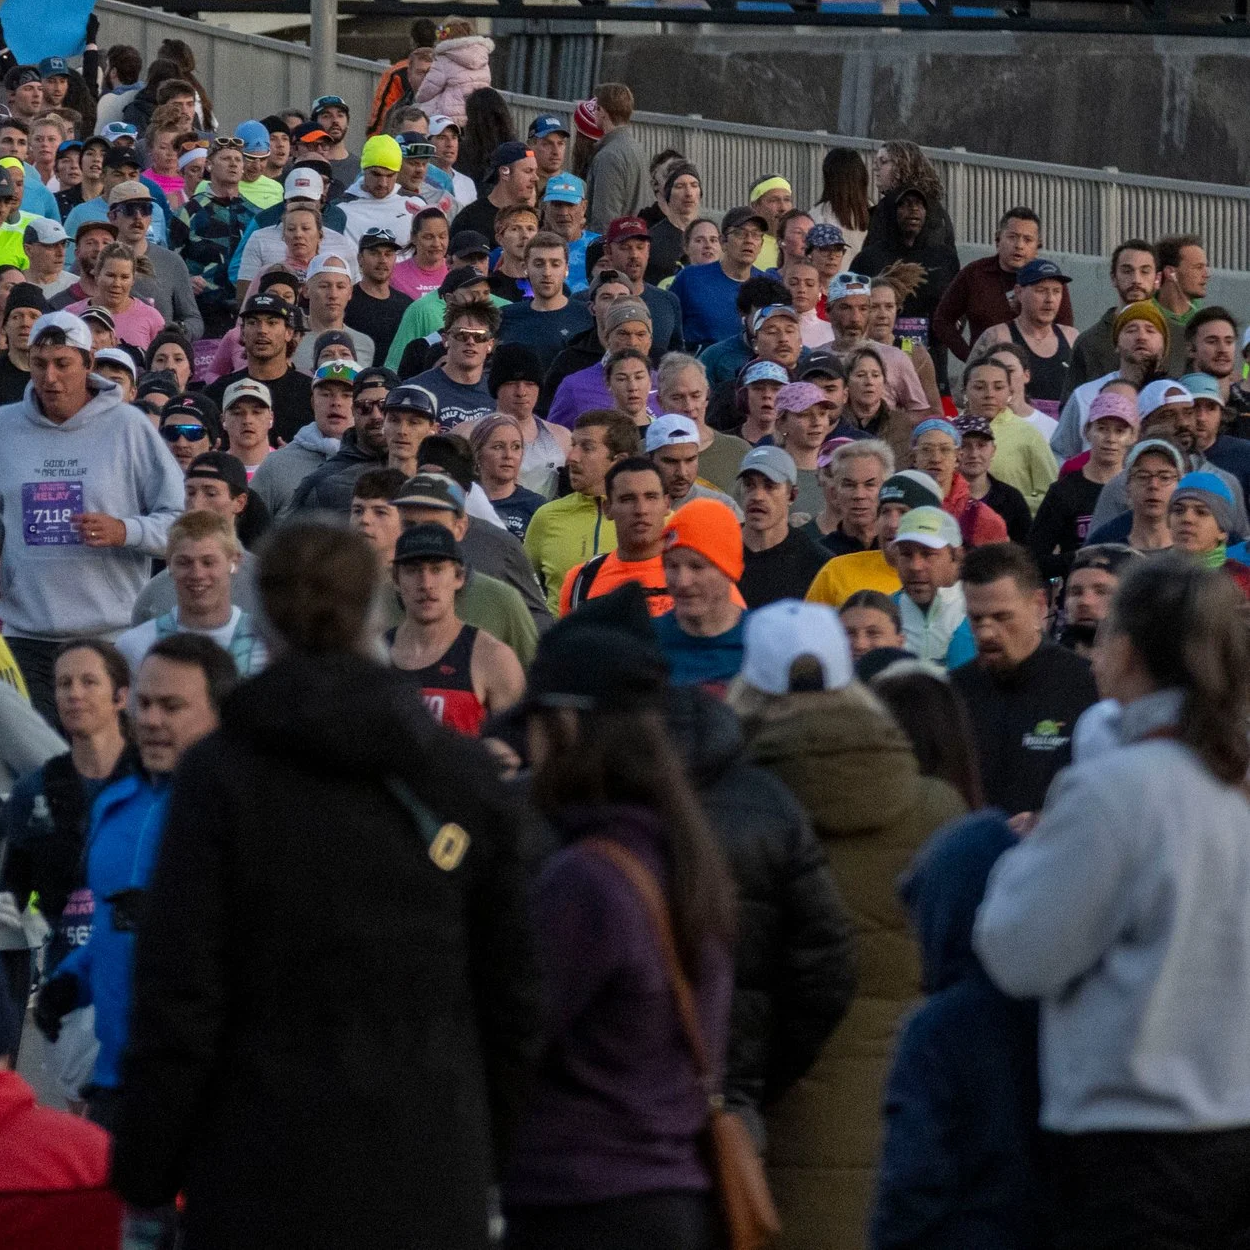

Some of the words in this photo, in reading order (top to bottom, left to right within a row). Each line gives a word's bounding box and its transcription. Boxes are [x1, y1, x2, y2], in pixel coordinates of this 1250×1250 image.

[440, 411, 458, 421] HALF
[44, 460, 66, 468] GOOD
[67, 459, 78, 467] AM
[41, 468, 57, 477] MAC
[59, 468, 88, 477] MILLER
[33, 491, 71, 501] RELAY
[33, 509, 71, 523] 7118
